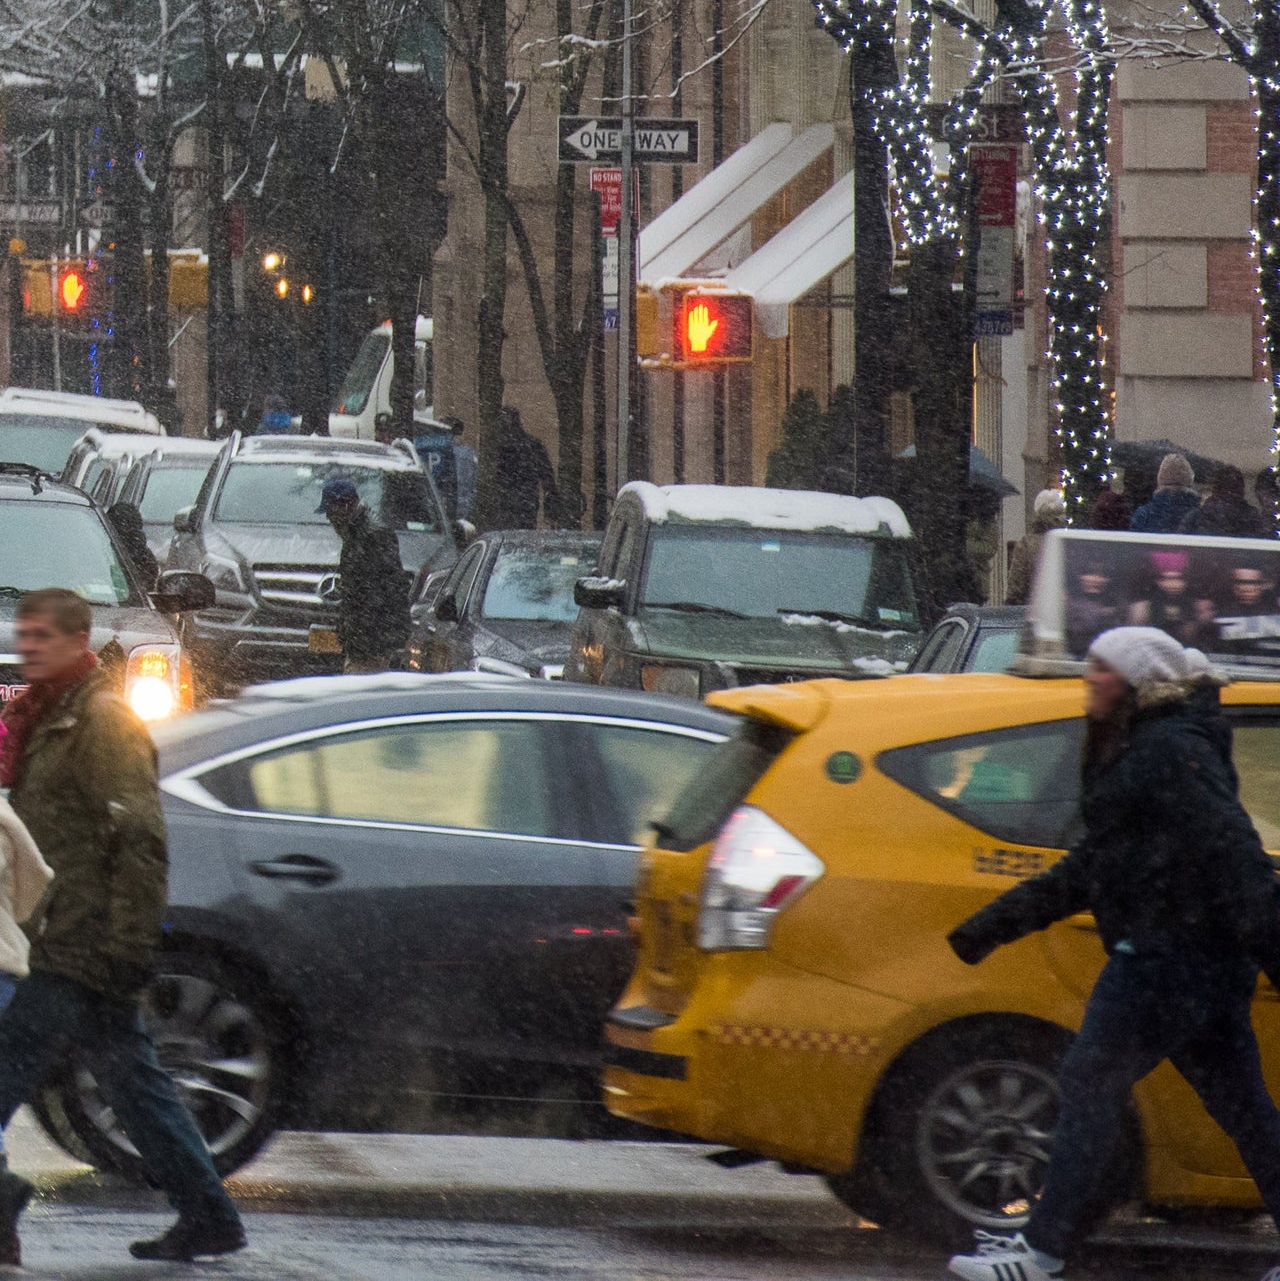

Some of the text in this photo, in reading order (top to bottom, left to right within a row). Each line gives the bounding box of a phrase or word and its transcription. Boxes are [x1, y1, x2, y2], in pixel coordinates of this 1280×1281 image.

[977, 114, 1000, 138] St
[580, 132, 679, 150] ONE WAY
